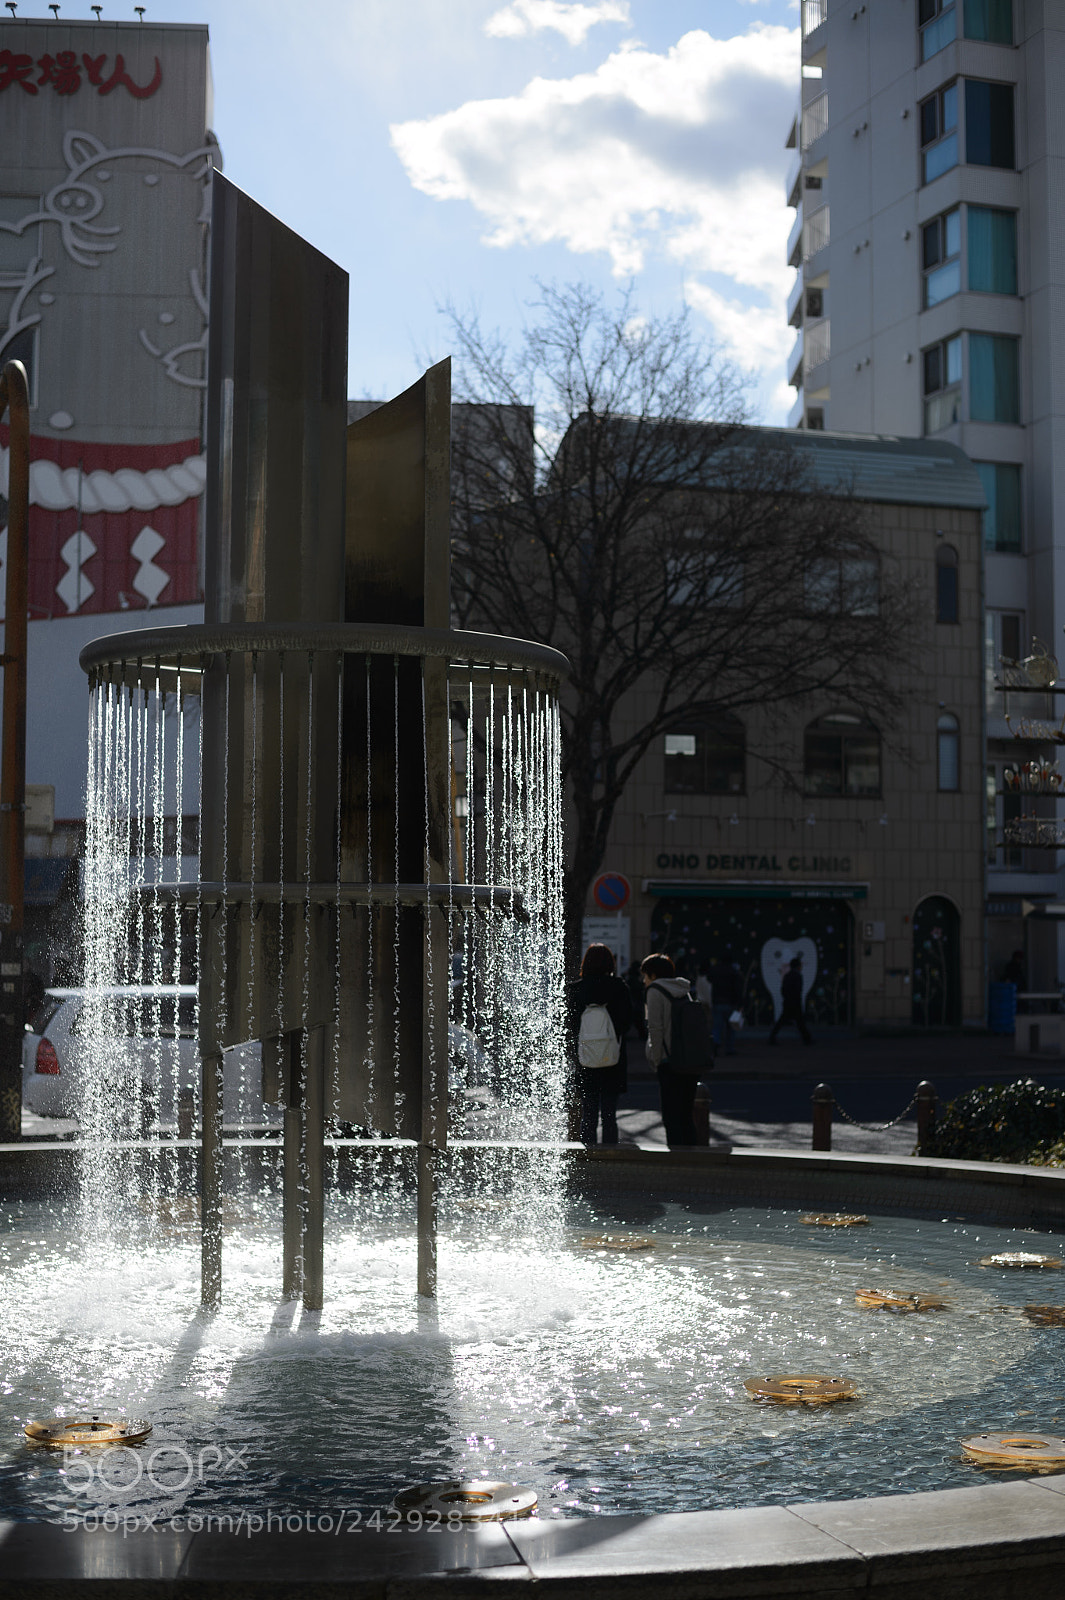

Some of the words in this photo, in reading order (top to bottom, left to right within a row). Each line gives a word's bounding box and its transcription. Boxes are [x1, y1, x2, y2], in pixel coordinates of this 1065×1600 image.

[656, 853, 700, 869] ONO
[706, 854, 782, 871] DENTAL
[788, 855, 851, 872] CLINIC
